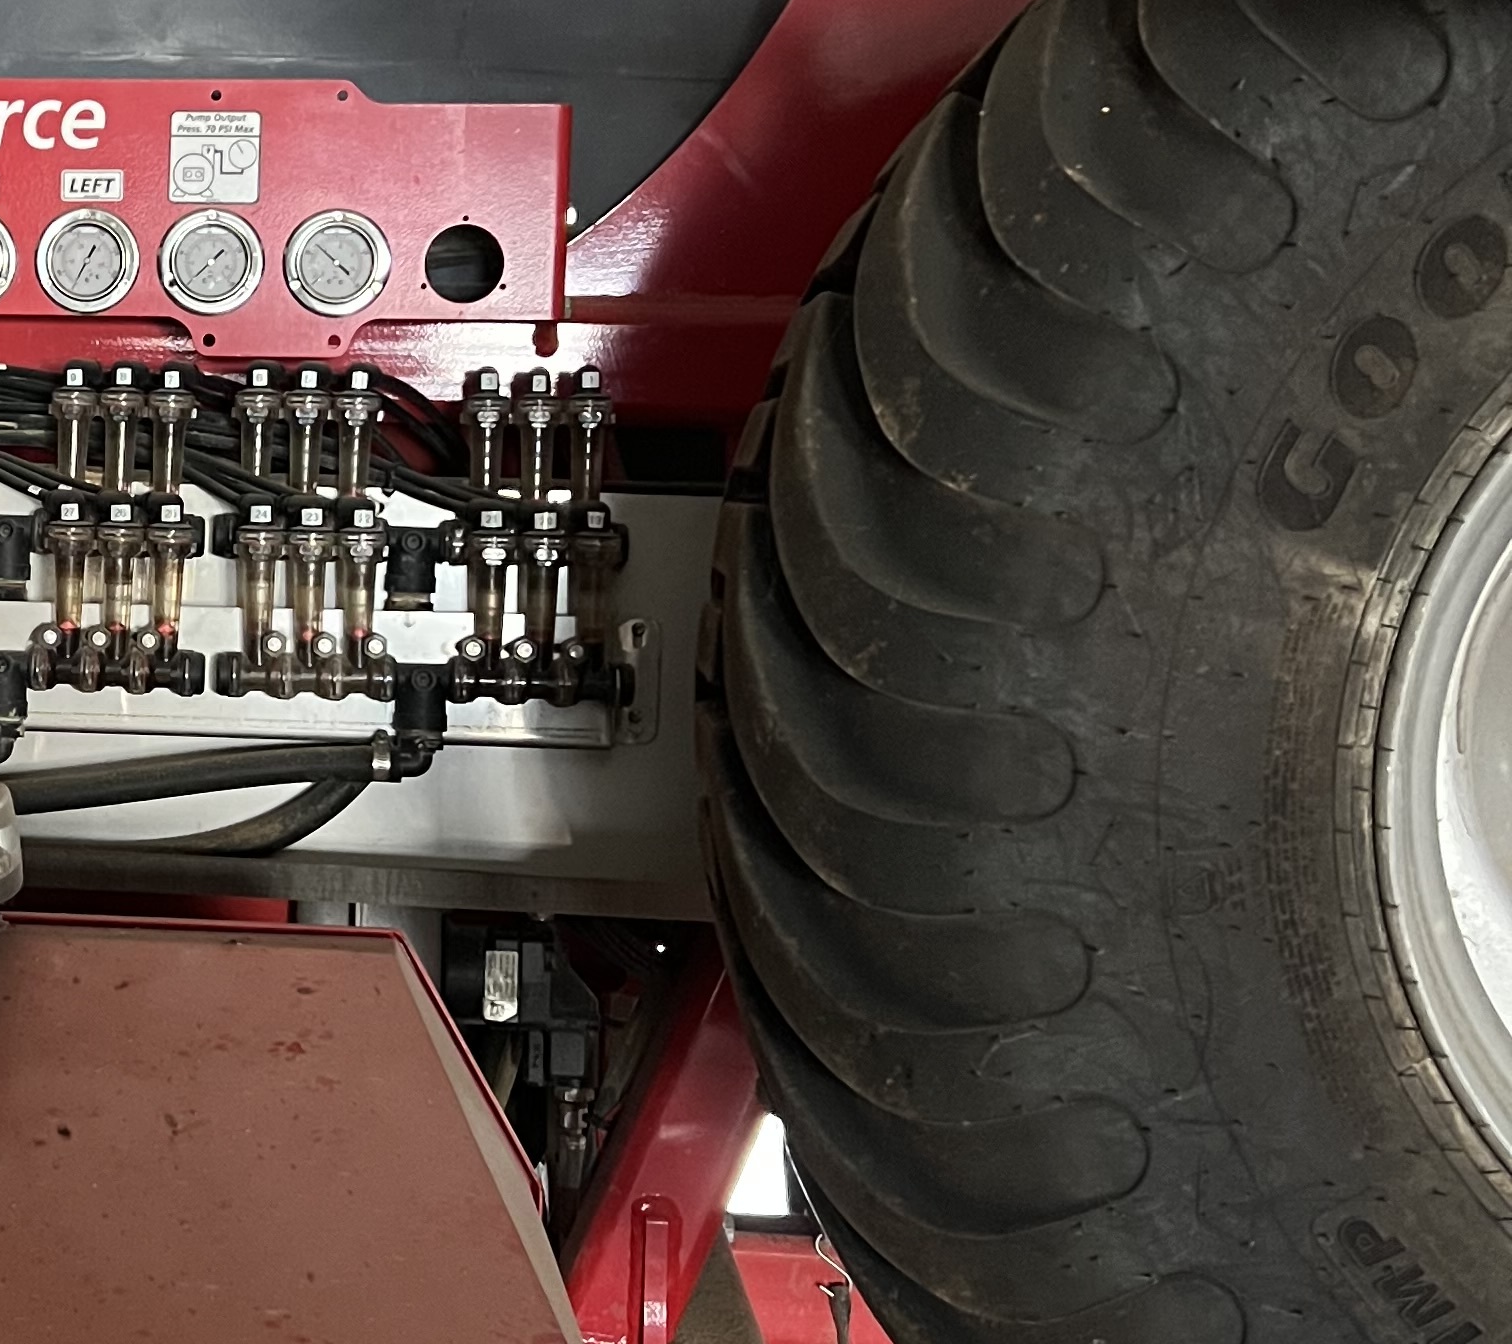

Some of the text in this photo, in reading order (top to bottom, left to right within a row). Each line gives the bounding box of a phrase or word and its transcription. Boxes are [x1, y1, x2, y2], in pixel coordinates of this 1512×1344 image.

[185, 113, 247, 123] Pump Output
[218, 125, 233, 133] PSI
[234, 125, 254, 133] Max
[69, 177, 116, 193] LEFT
